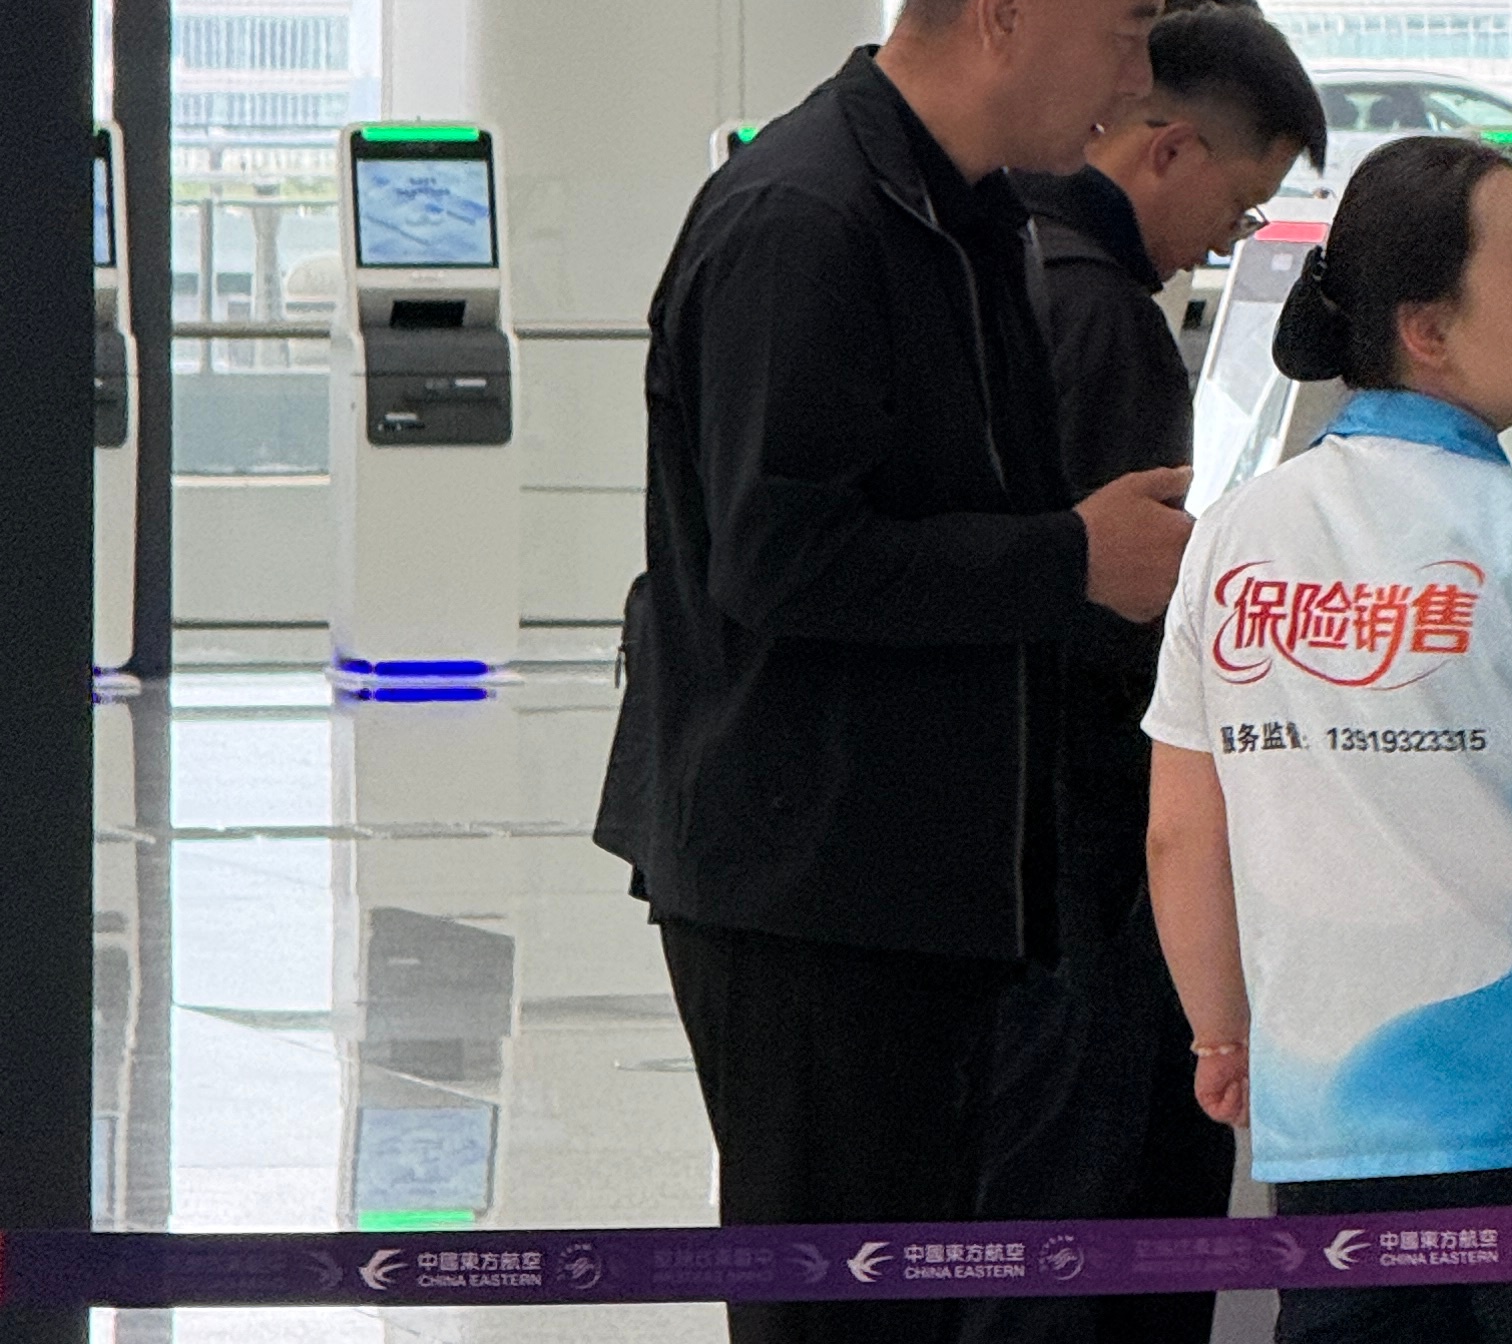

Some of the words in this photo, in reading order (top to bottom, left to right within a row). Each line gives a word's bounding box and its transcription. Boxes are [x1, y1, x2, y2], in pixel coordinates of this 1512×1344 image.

[1232, 576, 1479, 662] 保险销售
[1379, 1250, 1427, 1267] CHINA
[1429, 1249, 1500, 1265] EASTERN
[417, 1273, 467, 1288] CHINA
[469, 1273, 542, 1288] EASTERN
[904, 1264, 952, 1281] CHINA
[954, 1263, 1026, 1280] EASTERN
